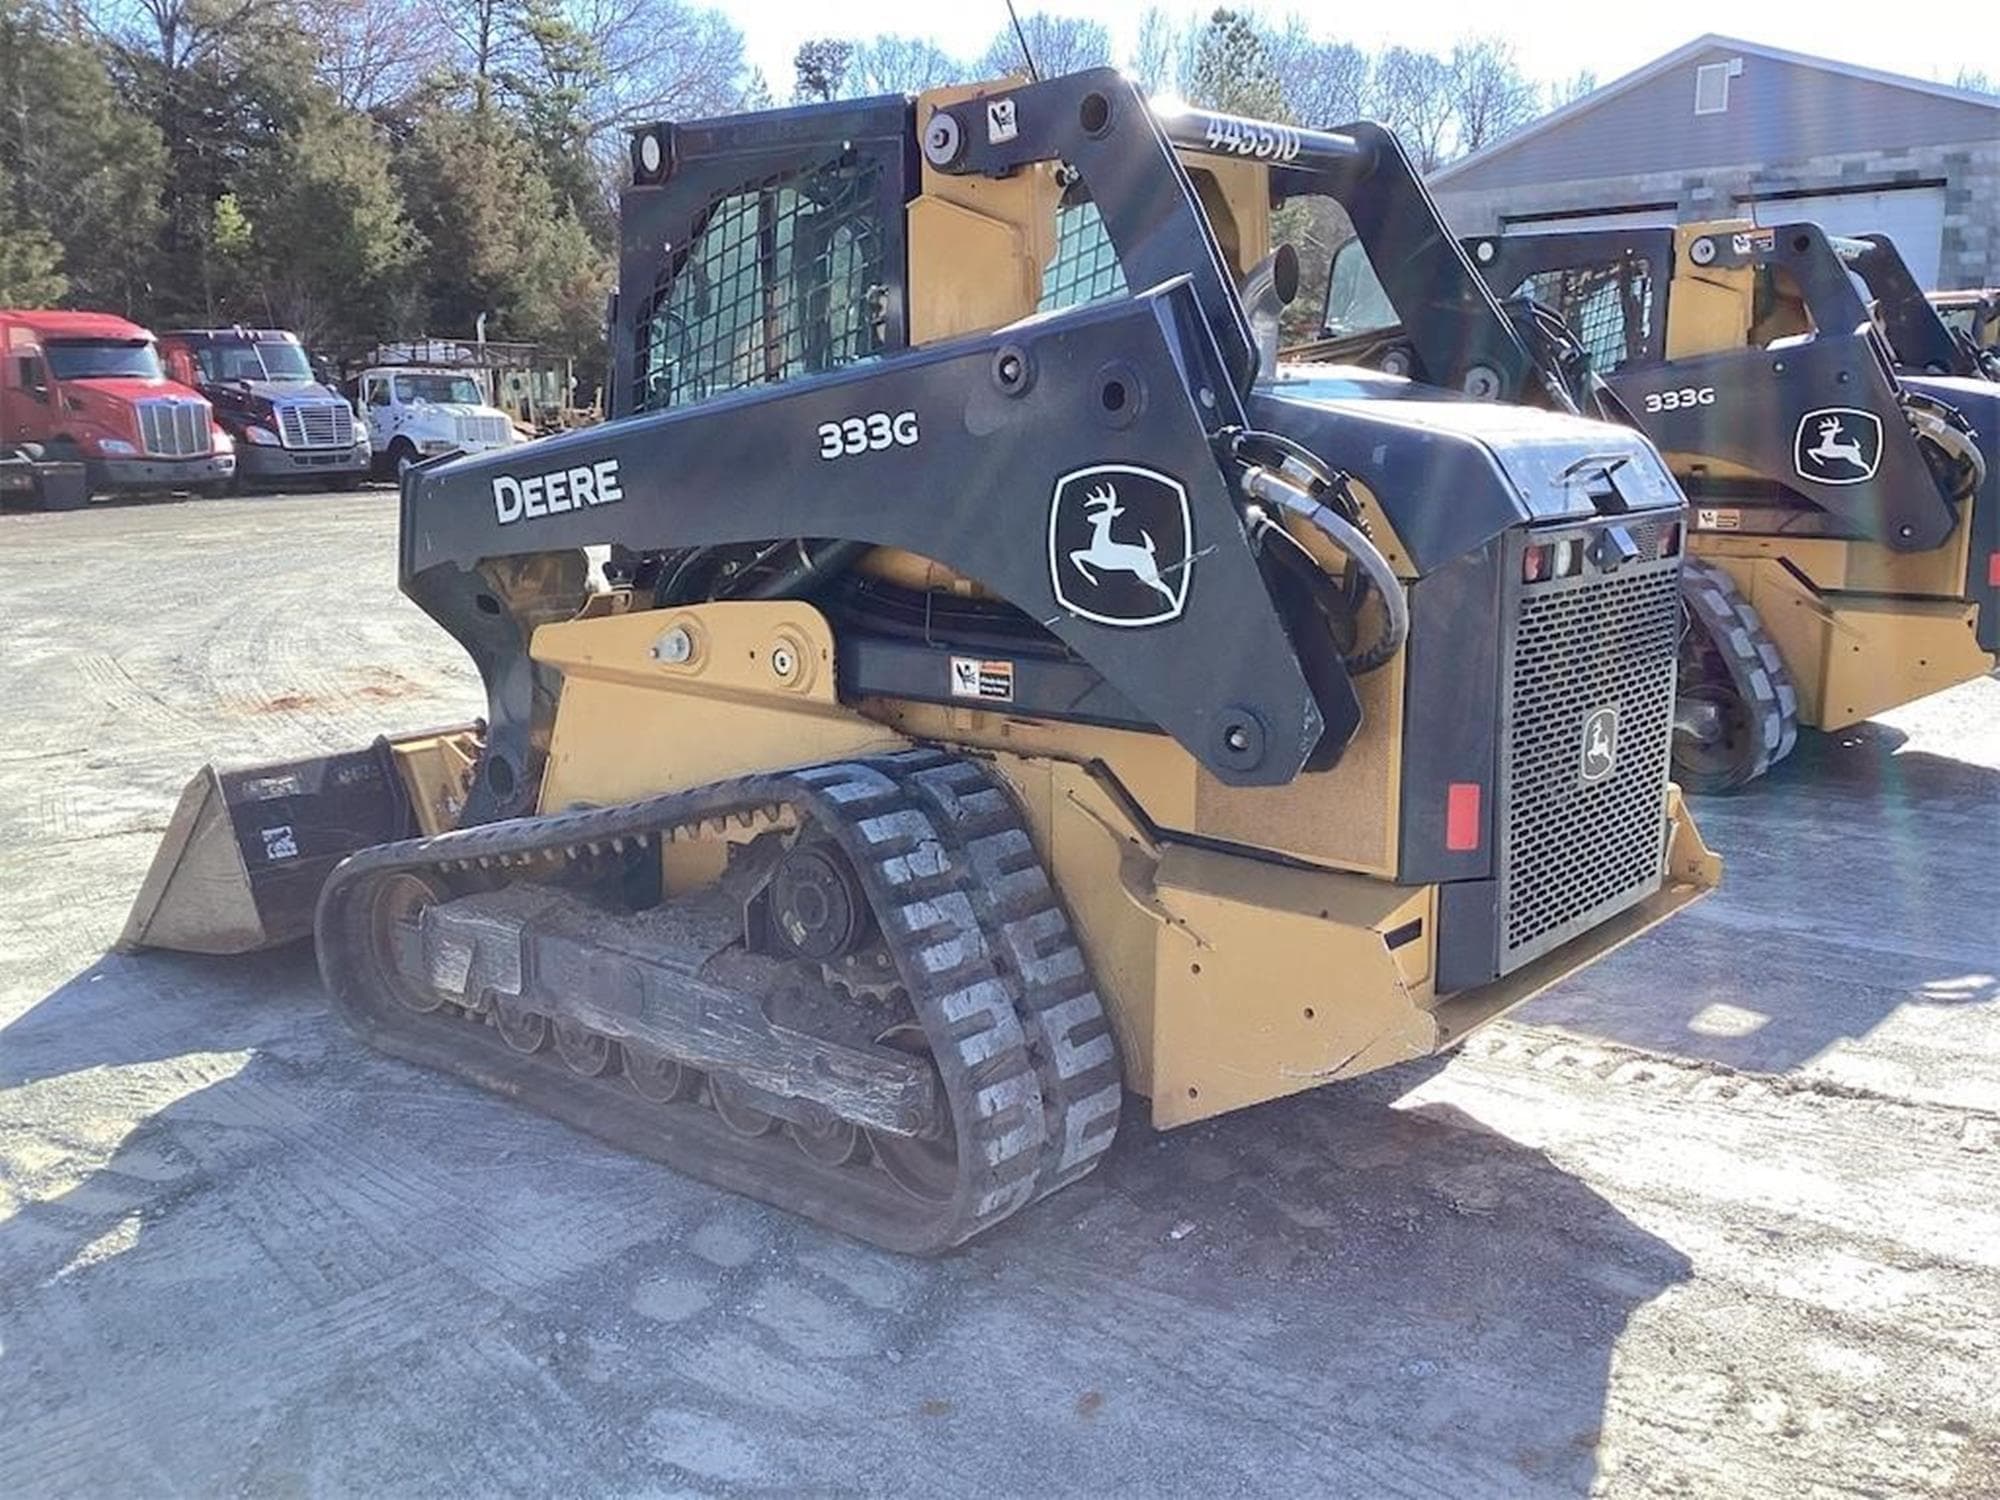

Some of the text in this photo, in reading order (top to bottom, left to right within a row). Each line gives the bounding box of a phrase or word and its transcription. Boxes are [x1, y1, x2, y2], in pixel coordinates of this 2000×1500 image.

[1645, 387, 1715, 412] 333G
[818, 411, 919, 459] 333G
[493, 459, 623, 524] DEERE
